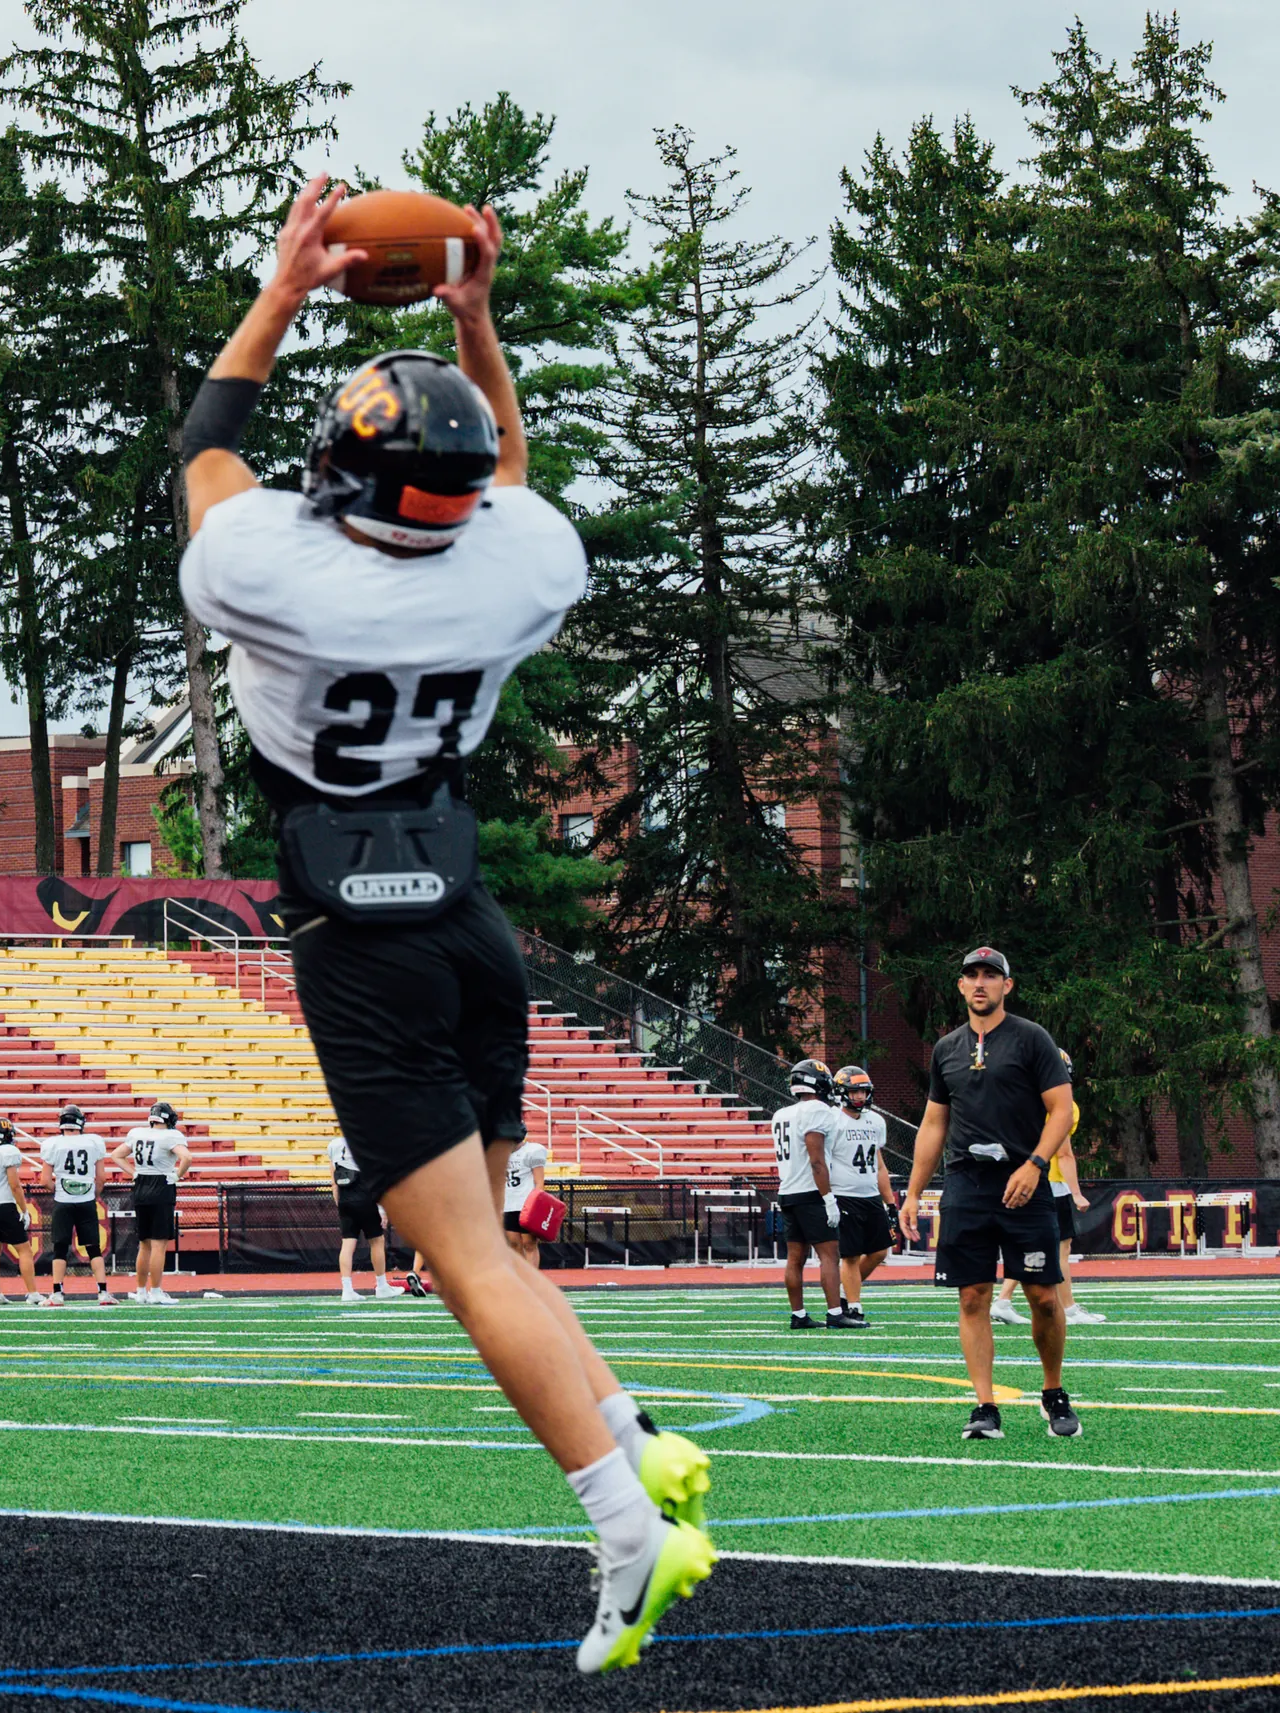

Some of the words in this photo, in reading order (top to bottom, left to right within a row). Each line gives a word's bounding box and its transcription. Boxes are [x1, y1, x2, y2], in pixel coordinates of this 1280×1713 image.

[337, 366, 400, 439] UC
[313, 669, 486, 781] 27
[351, 880, 438, 897] BATTLE
[134, 1139, 156, 1167] 87
[774, 1120, 791, 1162] 35
[852, 1143, 877, 1174] 44
[63, 1148, 90, 1176] 43
[1111, 1189, 1280, 1249] GRE
